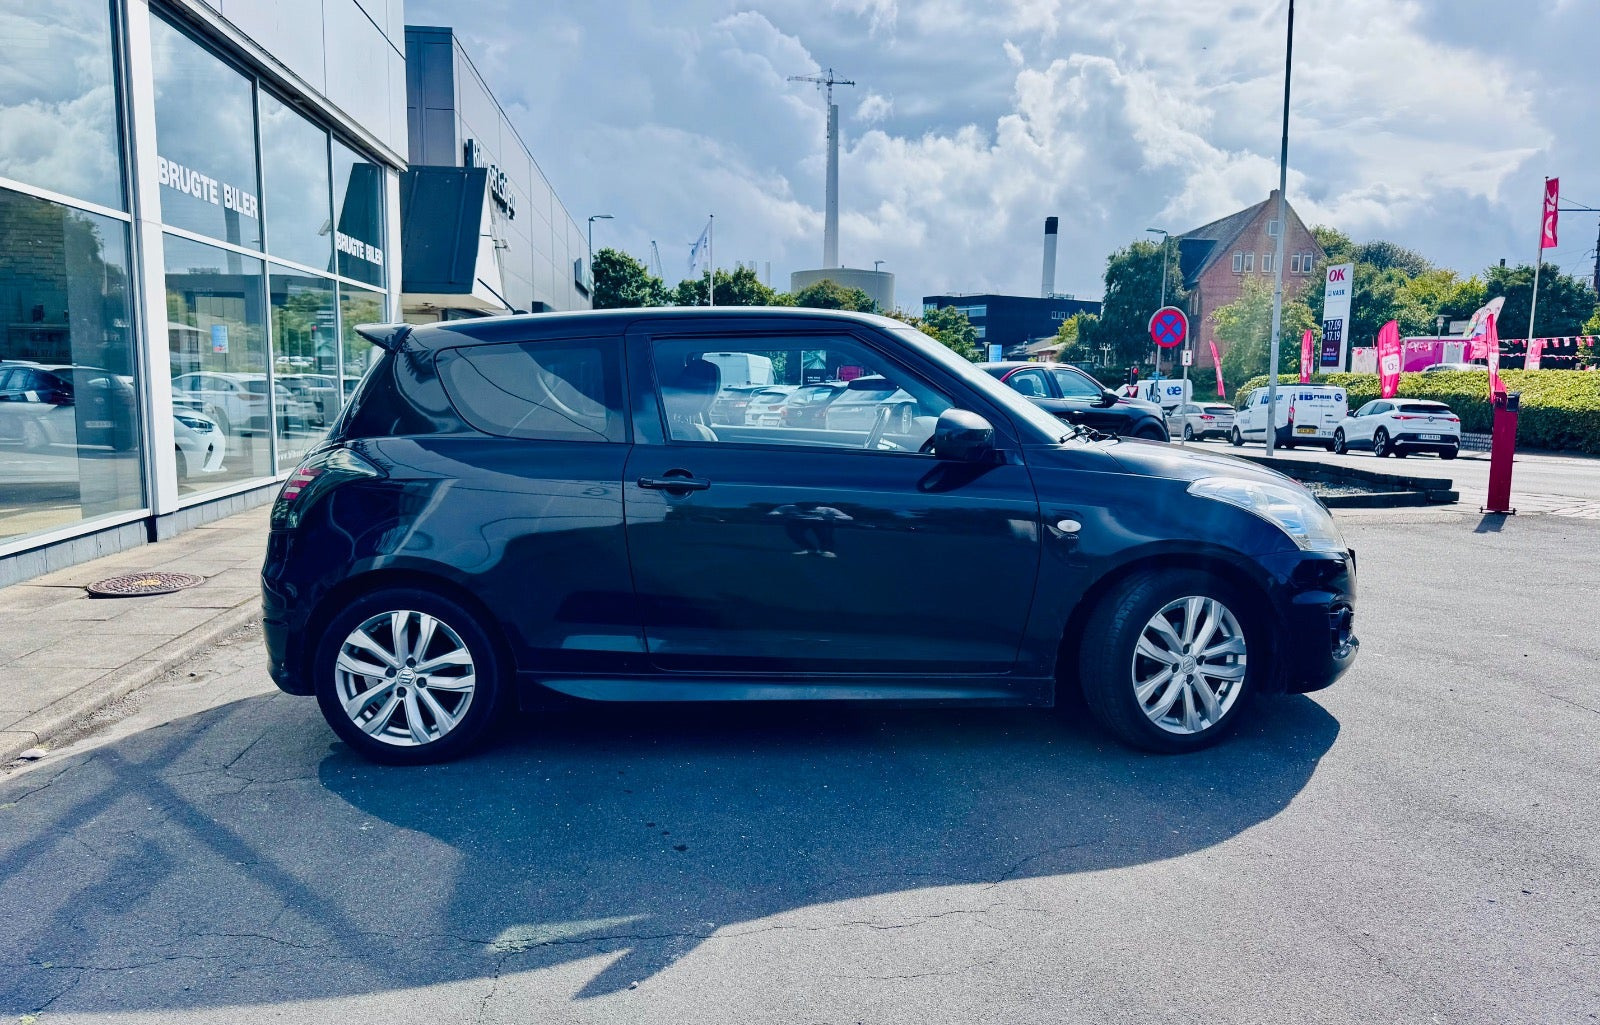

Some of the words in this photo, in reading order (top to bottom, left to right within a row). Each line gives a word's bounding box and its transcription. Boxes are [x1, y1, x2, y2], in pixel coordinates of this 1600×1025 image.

[158, 155, 219, 205] BRUGTE
[223, 183, 258, 220] BILER
[336, 230, 365, 260] BRUGTE
[365, 243, 384, 266] BILER
[1328, 268, 1345, 282] OK
[1326, 331, 1341, 341] 17.19
